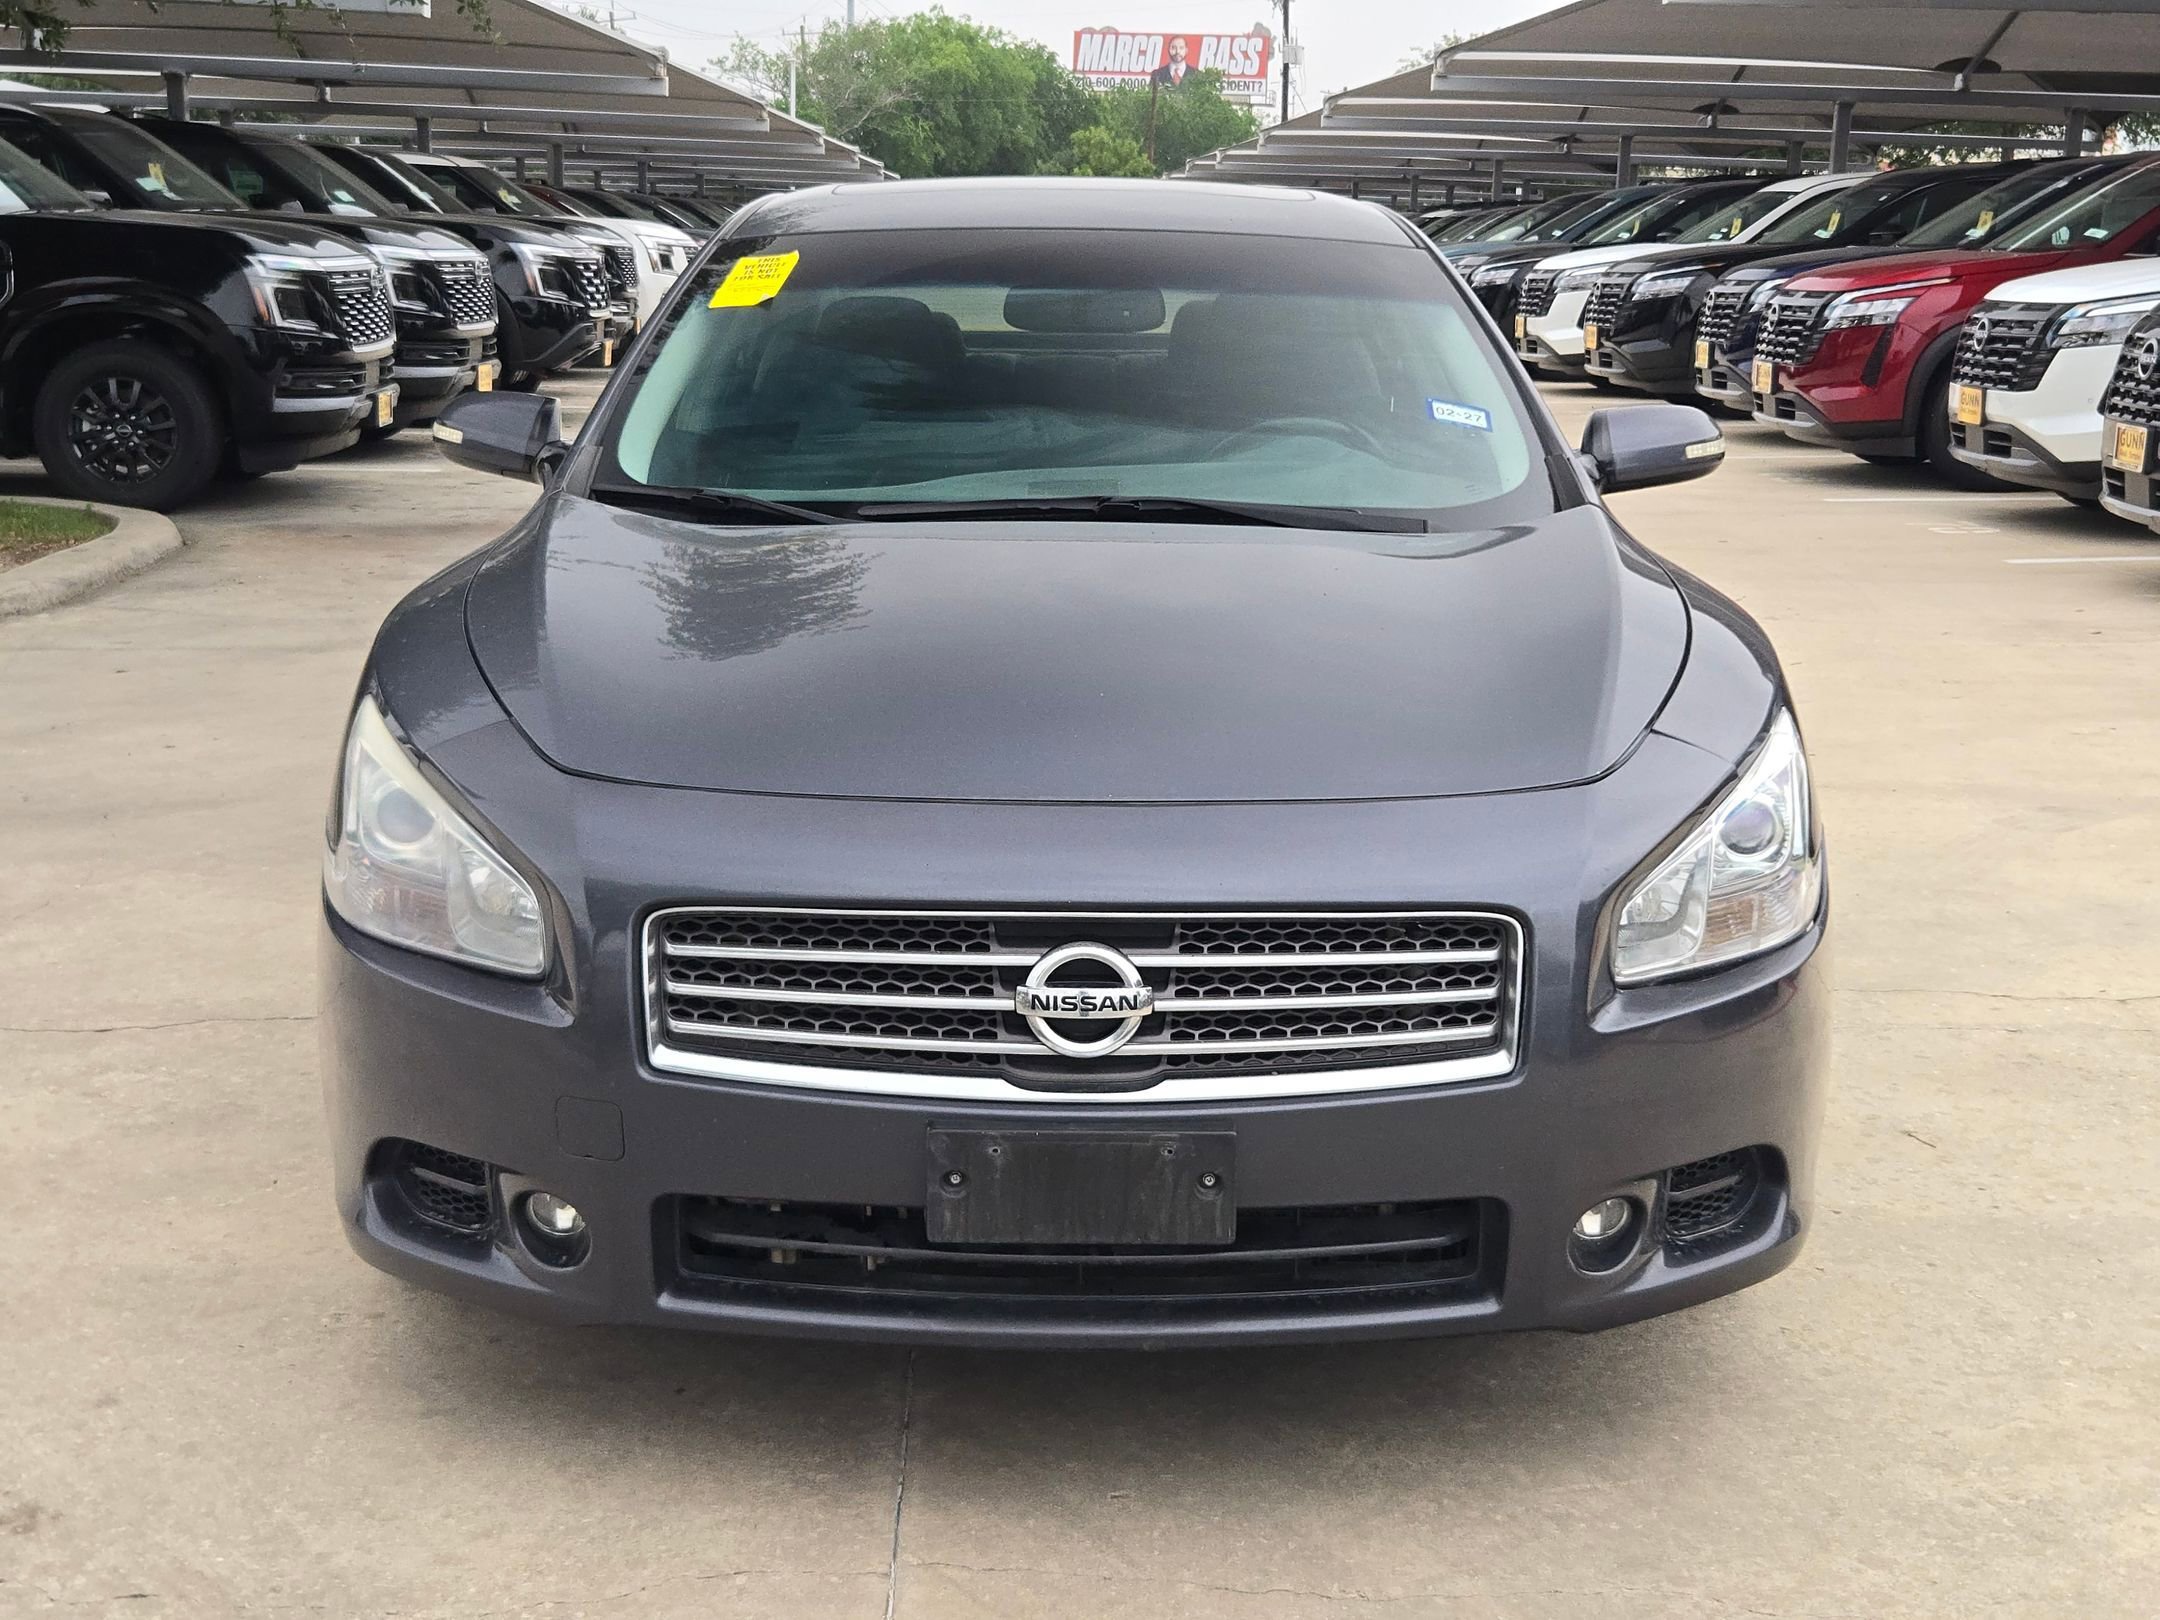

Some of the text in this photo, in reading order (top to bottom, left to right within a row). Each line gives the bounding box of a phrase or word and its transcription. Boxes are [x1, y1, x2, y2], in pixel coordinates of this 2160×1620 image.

[1077, 33, 1163, 73] MARCO
[1436, 406, 1482, 423] 02-27
[2120, 427, 2145, 451] GUNN
[1031, 994, 1138, 1012] NISSAN
